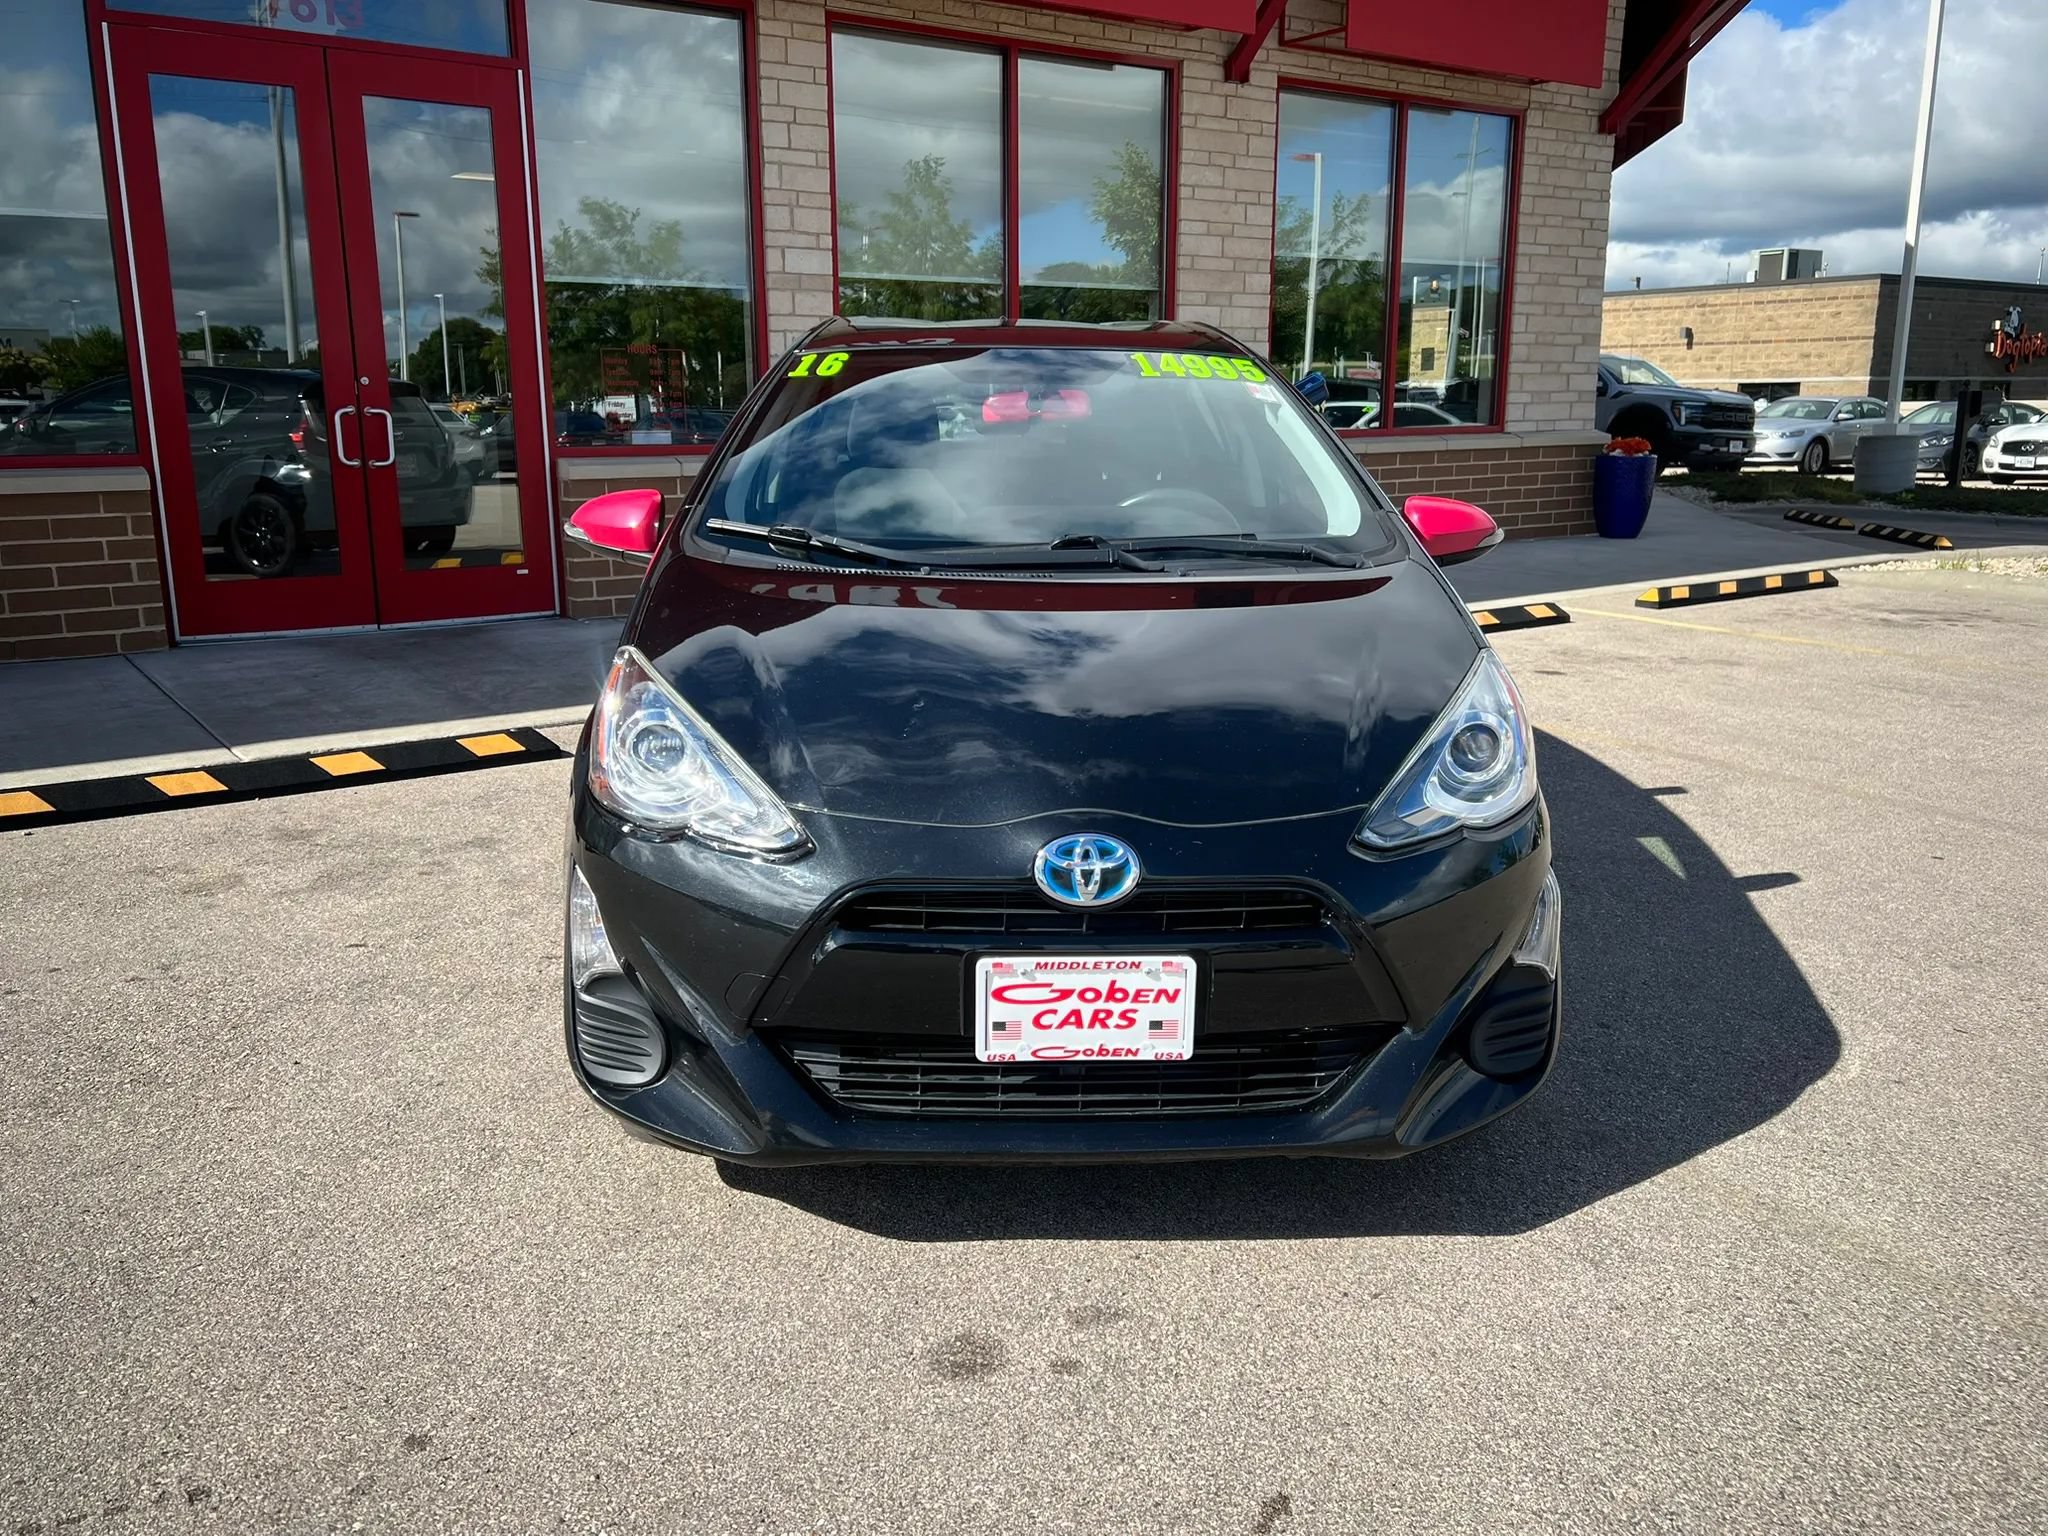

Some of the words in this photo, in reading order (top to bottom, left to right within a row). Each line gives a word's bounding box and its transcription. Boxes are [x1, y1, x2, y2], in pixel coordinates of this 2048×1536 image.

[626, 344, 657, 354] HOURS
[788, 353, 849, 377] 16
[1130, 352, 1267, 382] 14995
[1034, 961, 1142, 971] MIDDLETON
[1032, 1008, 1140, 1030] CARS
[987, 1053, 1017, 1062] USA
[1154, 1051, 1184, 1061] USA
